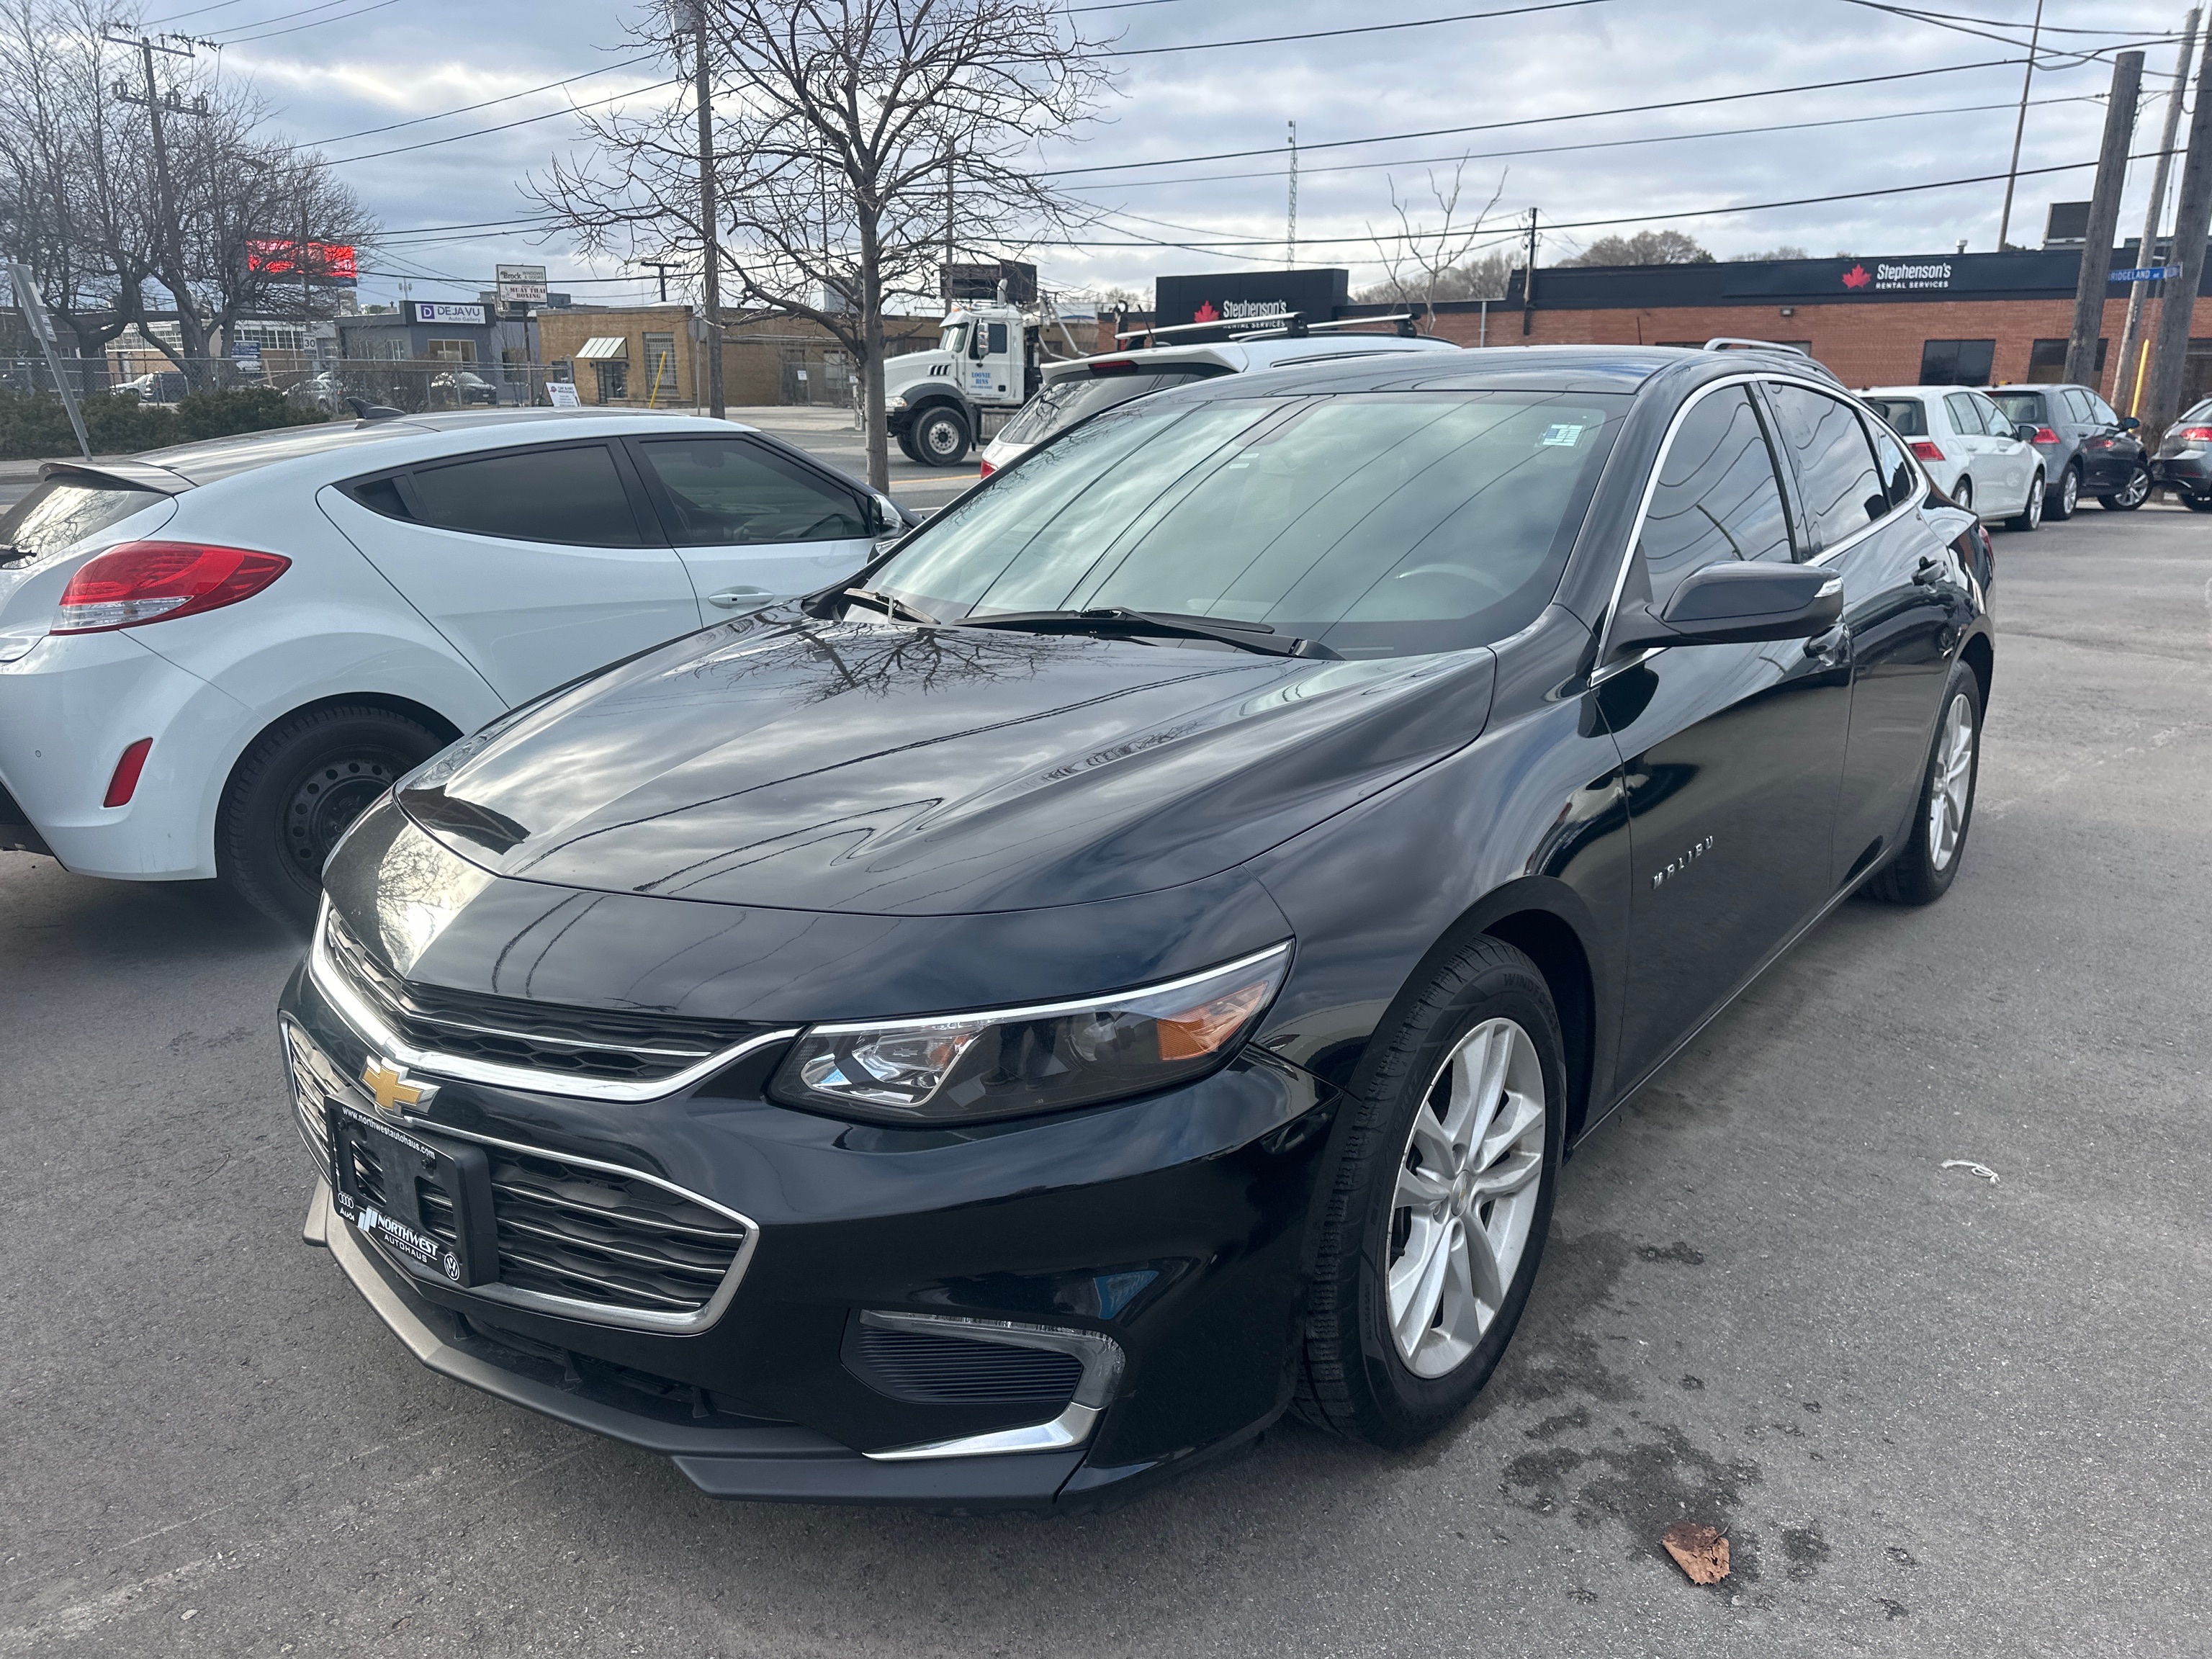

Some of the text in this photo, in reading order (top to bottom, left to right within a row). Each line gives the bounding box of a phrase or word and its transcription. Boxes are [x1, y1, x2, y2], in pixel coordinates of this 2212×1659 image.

[1876, 263, 1952, 282] Stephenson's
[2108, 269, 2151, 282] RIDGELAND
[1223, 300, 1287, 319] Stephenson's
[1251, 320, 1286, 328] SERVICES
[304, 339, 315, 348] 30
[1652, 835, 1713, 889] MALIBU
[342, 1106, 436, 1160] www.northwestautohaus.com
[340, 1207, 355, 1222] Audi
[377, 1214, 439, 1257] NORTHWEST
[384, 1234, 428, 1263] AUTOHAUS
